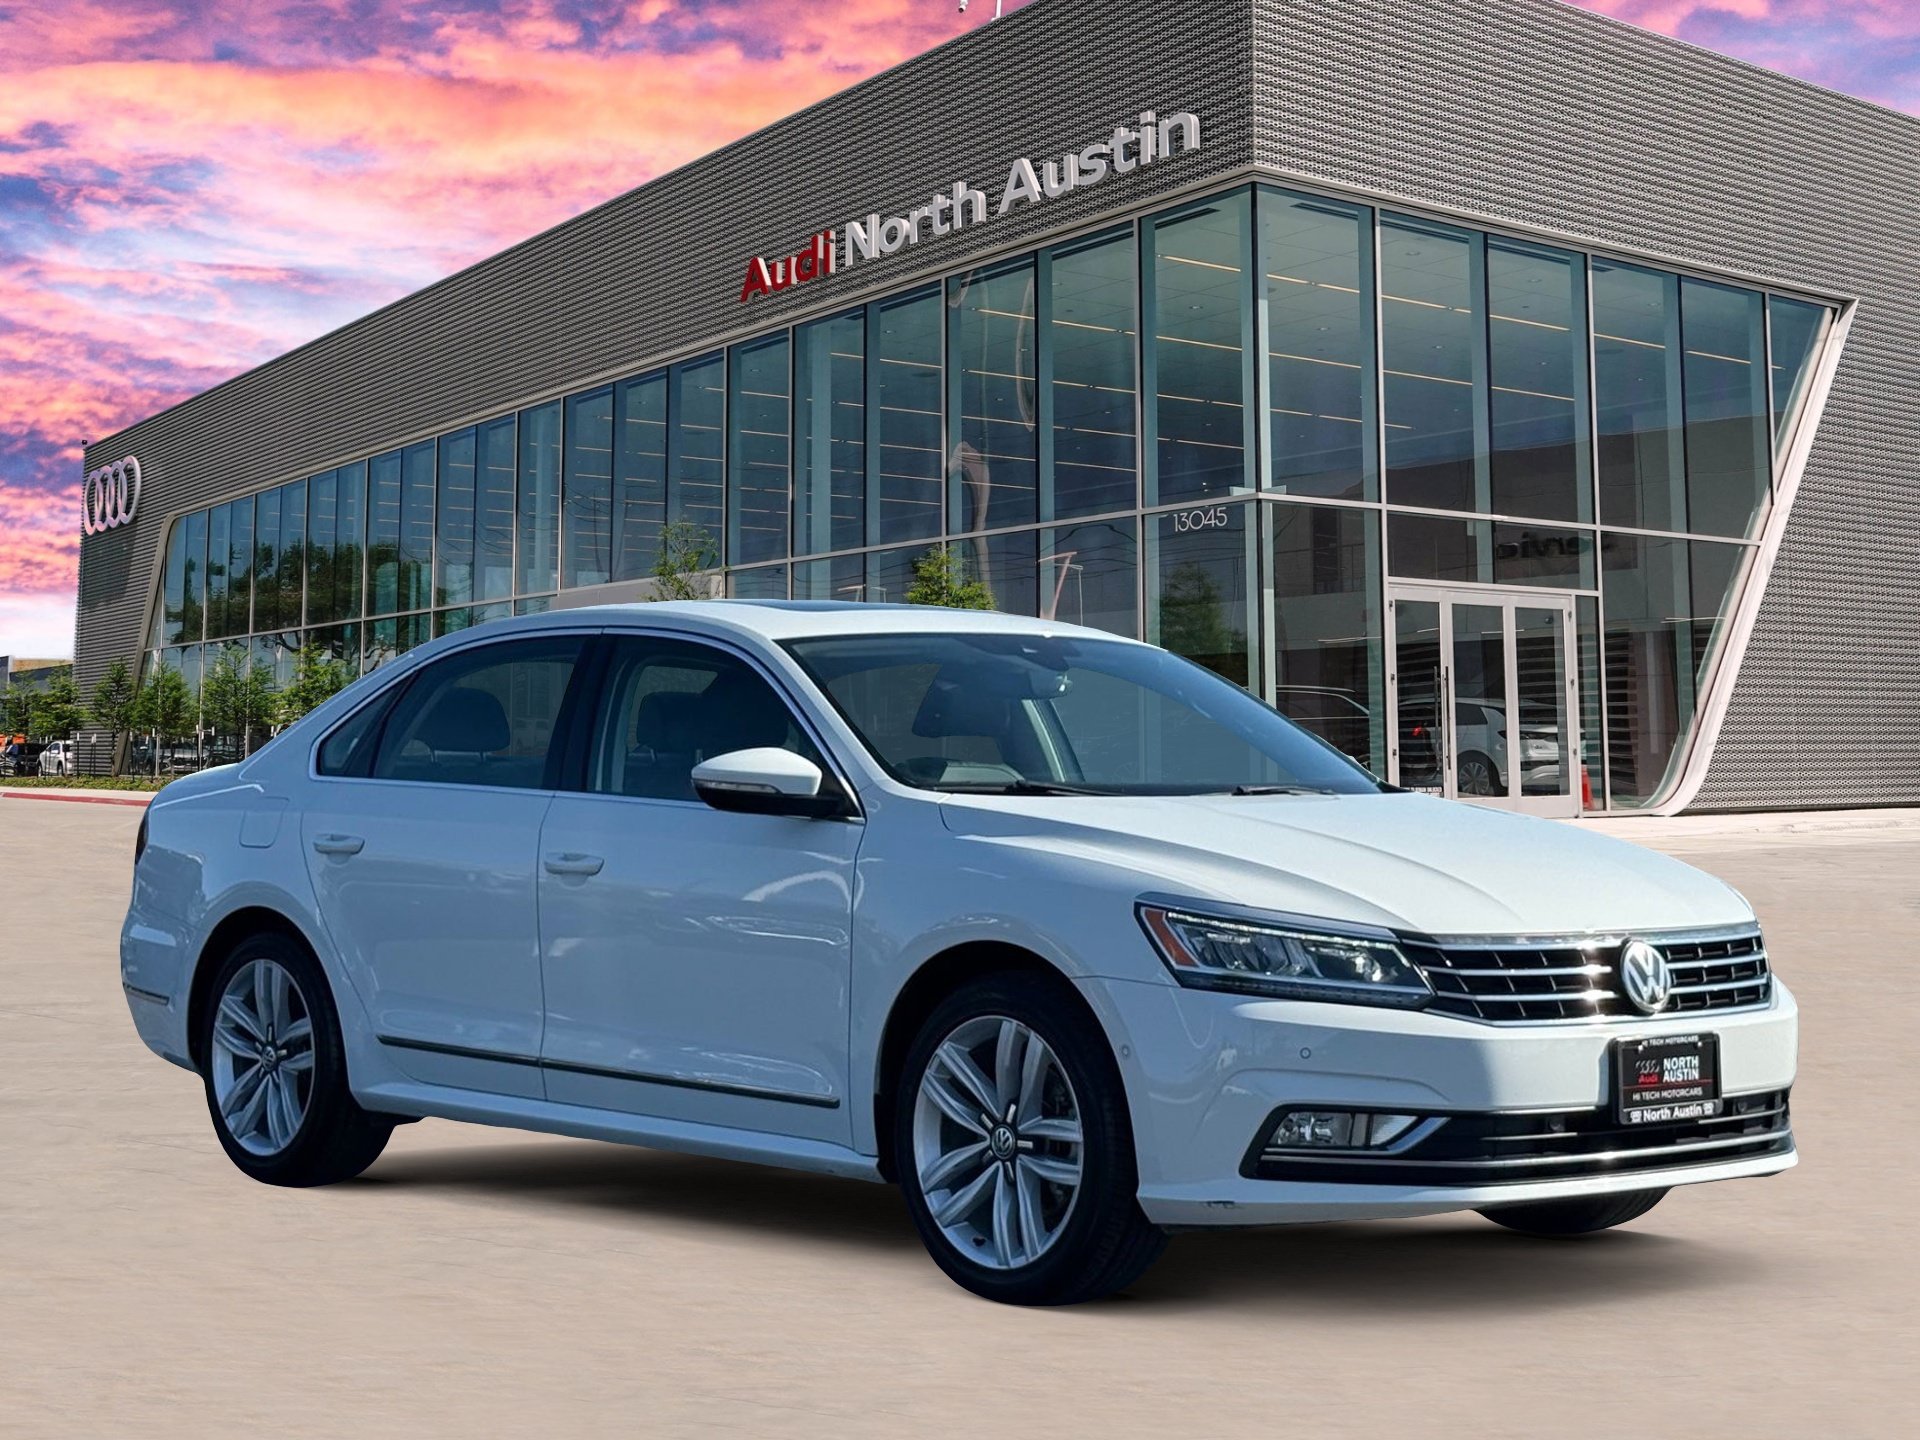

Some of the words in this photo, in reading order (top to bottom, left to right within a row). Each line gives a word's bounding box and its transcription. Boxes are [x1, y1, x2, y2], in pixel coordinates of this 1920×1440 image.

[740, 230, 836, 302] Audi
[845, 181, 987, 267] North
[999, 110, 1201, 213] Austin
[1173, 507, 1228, 532] 13045
[1663, 1055, 1699, 1070] NORTH
[1639, 1074, 1658, 1083] Audi
[1663, 1068, 1699, 1082] AUSTIN
[1642, 1090, 1660, 1099] TECH
[1661, 1087, 1703, 1098] MOTORCARS
[1643, 1108, 1671, 1122] North
[1673, 1103, 1702, 1117] Austin
